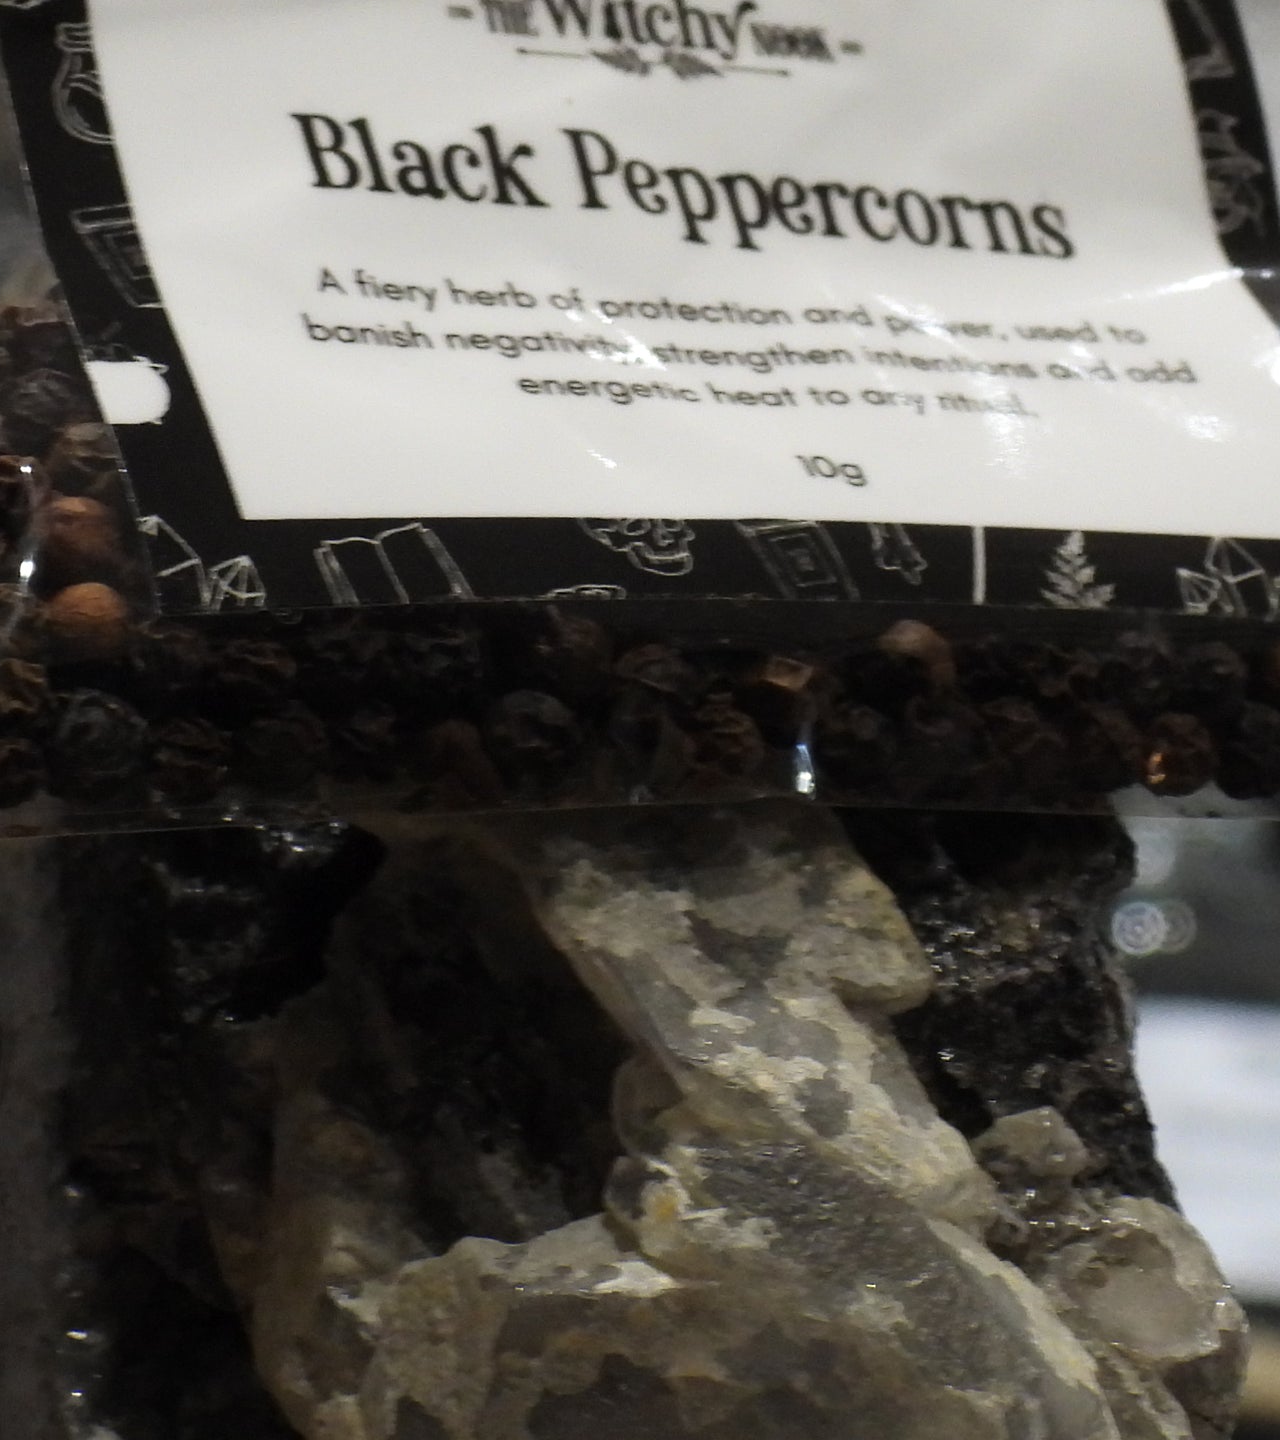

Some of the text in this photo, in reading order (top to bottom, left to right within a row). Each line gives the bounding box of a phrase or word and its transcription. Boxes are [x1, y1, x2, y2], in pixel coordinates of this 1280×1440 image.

[290, 112, 1074, 258] Black Peppercorns
[318, 267, 347, 294] A
[353, 268, 437, 311] fiery
[444, 277, 537, 309] herb
[549, 287, 583, 311] of
[599, 296, 793, 325] protection
[803, 305, 873, 327] and
[1016, 319, 1099, 343] used
[1107, 324, 1147, 345] to
[300, 312, 435, 350] banish
[652, 341, 854, 373] strengthen
[1125, 360, 1197, 383] add
[518, 376, 701, 405] energetic
[707, 382, 797, 407] heat
[809, 388, 850, 405] to
[794, 455, 867, 487] 10g
